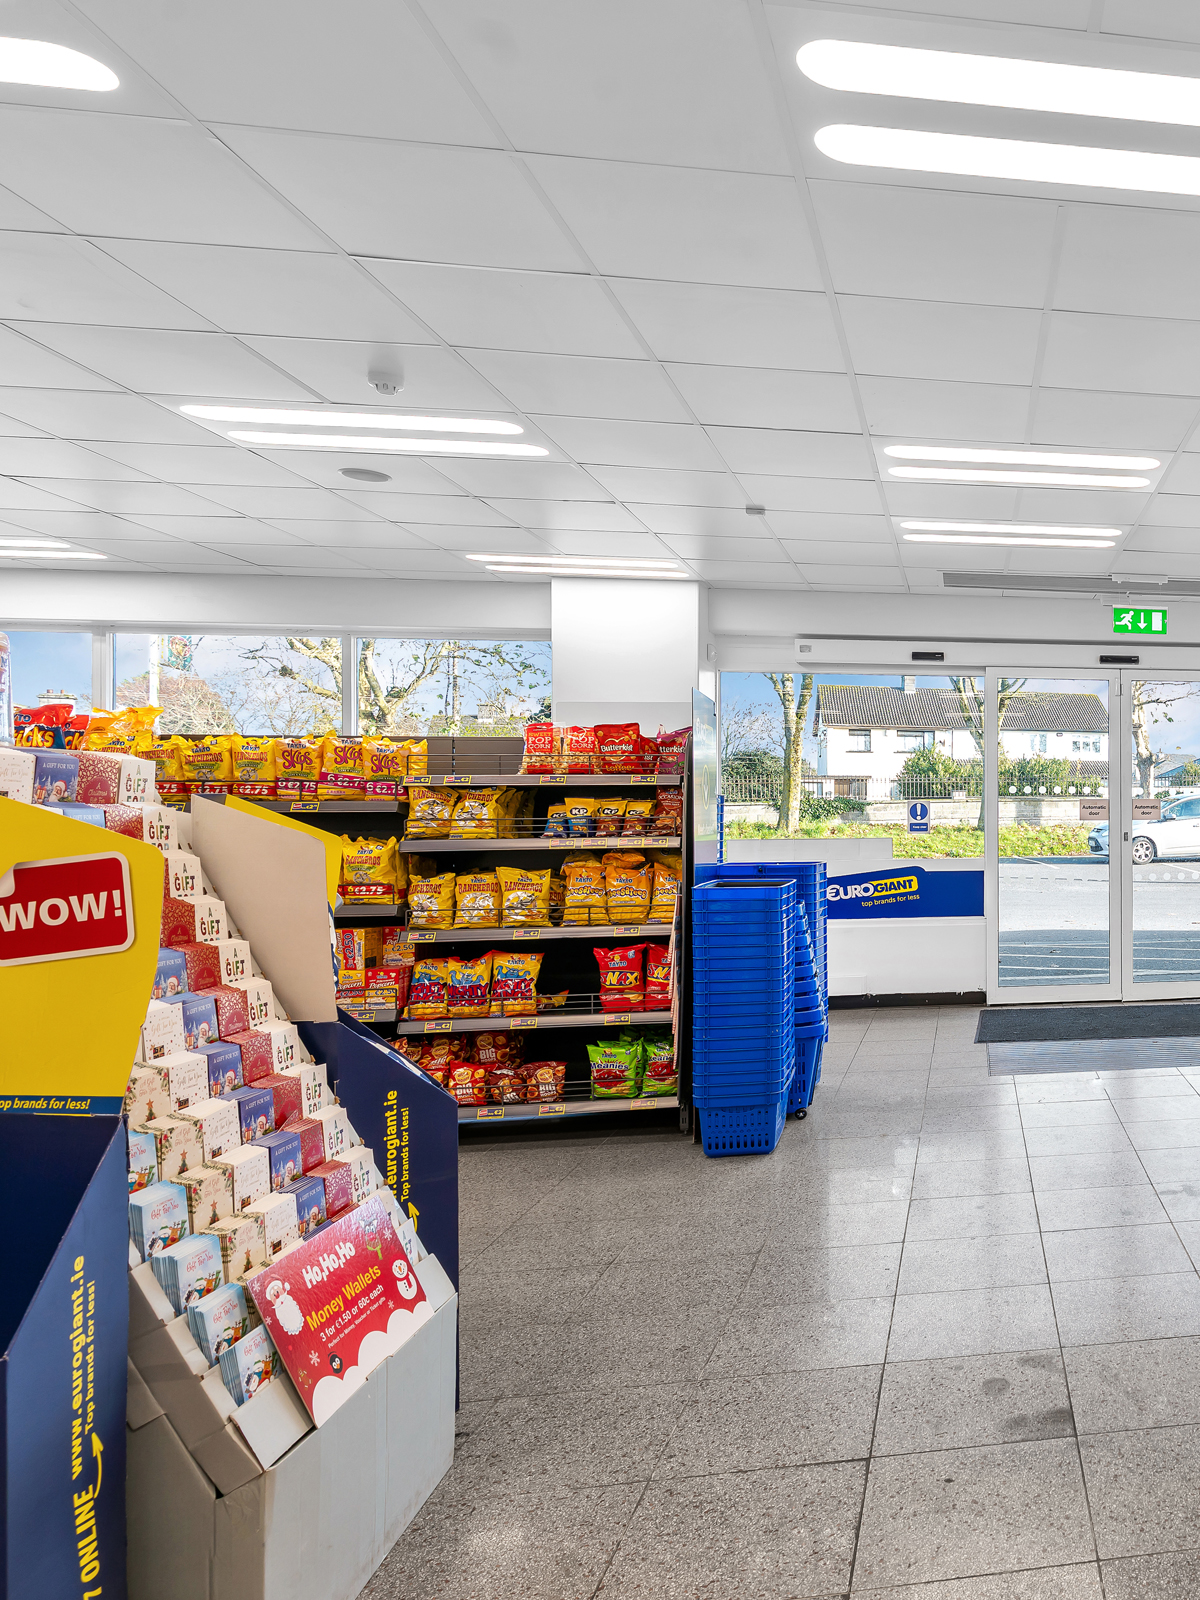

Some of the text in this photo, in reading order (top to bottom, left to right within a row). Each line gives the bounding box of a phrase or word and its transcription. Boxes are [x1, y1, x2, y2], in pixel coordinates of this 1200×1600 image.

[126, 778, 148, 794] GIFT
[239, 784, 268, 794] €2.75
[158, 812, 162, 822] A
[149, 824, 170, 840] GIFT
[183, 863, 187, 873] A
[174, 876, 195, 891] GIFT
[354, 886, 383, 895] €2.75
[458, 882, 499, 894] RANCHEROS
[504, 881, 543, 892] RANCHEROS
[0, 889, 123, 932] WOW!
[862, 899, 873, 908] top
[600, 972, 638, 985] SNAX
[480, 1048, 496, 1059] BIG
[0, 1098, 90, 1110] op brands for less!
[384, 1090, 400, 1198] .eurogiant.ie
[401, 1131, 409, 1146] for
[401, 1147, 409, 1182] brands
[401, 1184, 410, 1202] Top
[302, 1240, 356, 1289] Ho,Ho,Ho
[306, 1264, 381, 1332] Money Wallets
[320, 1284, 384, 1341] 3 for €1.50 or 60c each
[328, 1336, 340, 1348] Perfect
[354, 1313, 367, 1325] Voucher
[370, 1303, 380, 1312] Ticket
[85, 1281, 95, 1434] Top brands for less!
[69, 1255, 102, 1583] ONLINE www.eurogiant.ie
